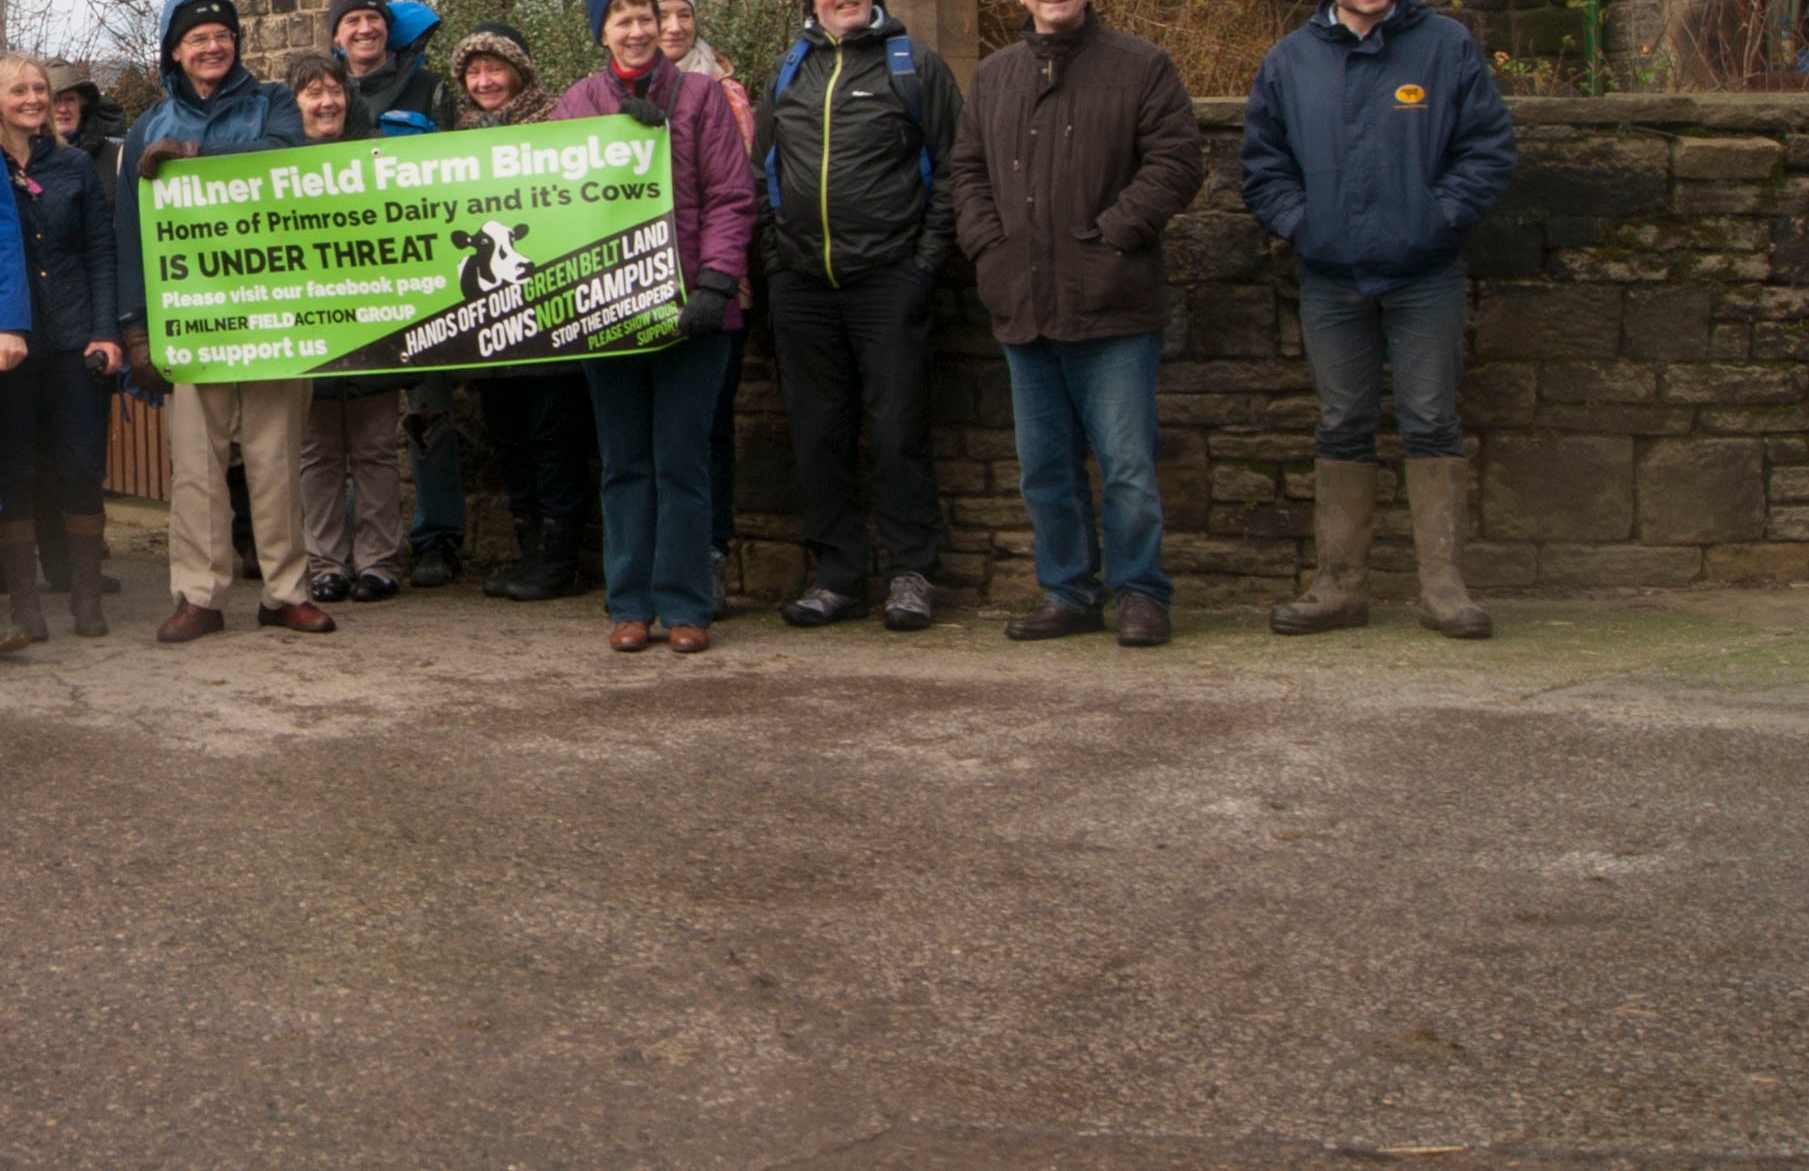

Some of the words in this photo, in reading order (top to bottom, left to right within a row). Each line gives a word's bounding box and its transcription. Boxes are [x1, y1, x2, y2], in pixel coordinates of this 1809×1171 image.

[152, 175, 263, 209] Milner
[270, 159, 365, 199] Field
[374, 155, 480, 189] Farm
[492, 135, 655, 180] Bingley
[157, 221, 228, 241] Home
[236, 212, 260, 235] of
[267, 210, 377, 232] Primrose
[385, 197, 458, 223] Dairy
[467, 188, 522, 214] and
[531, 184, 572, 208] it's
[580, 181, 661, 203] Cows
[160, 254, 189, 281] IS
[198, 245, 307, 278] UNDER
[313, 233, 438, 269] THREAT
[162, 289, 226, 309] Please
[230, 284, 269, 304] visit
[272, 284, 302, 301] our
[306, 276, 394, 298] facebook
[396, 276, 446, 295] page
[405, 312, 458, 356] HANDS
[457, 298, 487, 332] OFF
[488, 284, 523, 318] OUR
[523, 256, 579, 302] GREEN
[579, 238, 620, 278] BELT
[621, 220, 669, 260] LAND
[552, 321, 581, 348] STOP
[587, 324, 624, 350] PLEASE
[623, 310, 652, 335] SHOW
[651, 300, 678, 322] YOUR
[636, 315, 679, 346] SUPPORT
[166, 345, 192, 365] to
[198, 337, 294, 367] support
[299, 338, 327, 357] us
